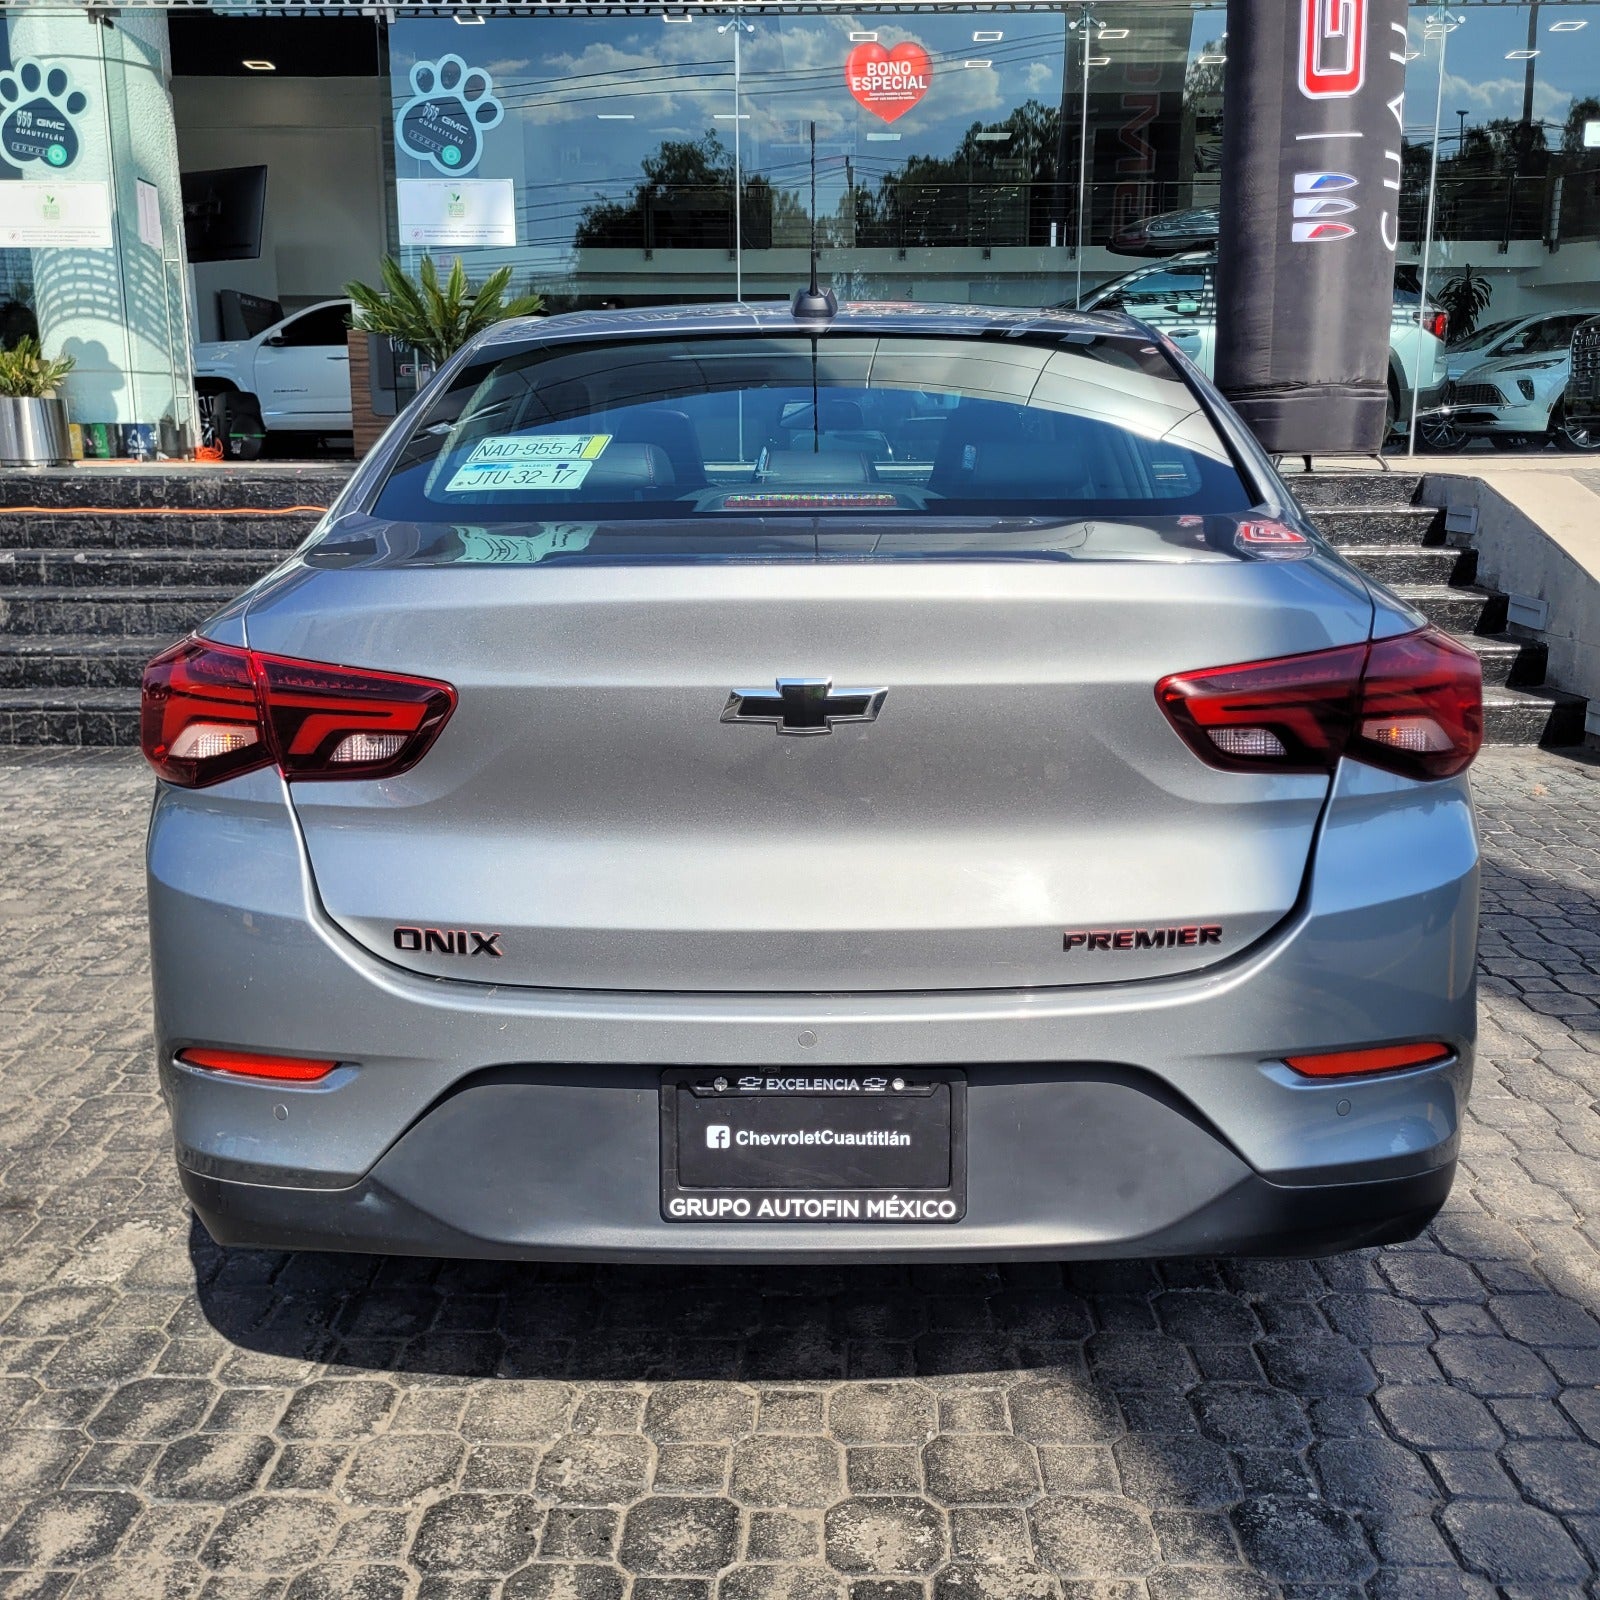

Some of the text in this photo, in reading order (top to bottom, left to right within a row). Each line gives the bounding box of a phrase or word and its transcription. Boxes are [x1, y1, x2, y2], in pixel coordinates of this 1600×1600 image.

[866, 61, 912, 76] BONO
[851, 75, 928, 91] ESPECIAL
[36, 118, 66, 130] GMC
[441, 115, 469, 135] GMC
[476, 442, 583, 457] NAD-955-A
[467, 469, 577, 485] JTU-32-17
[393, 926, 503, 956] ONIX
[1063, 924, 1223, 952] PREMIER
[765, 1078, 860, 1091] EXCELENCIA
[736, 1130, 911, 1146] ChevroletCuautitlán
[669, 1195, 956, 1218] GRUPO AUTOFIN MÉXICO
